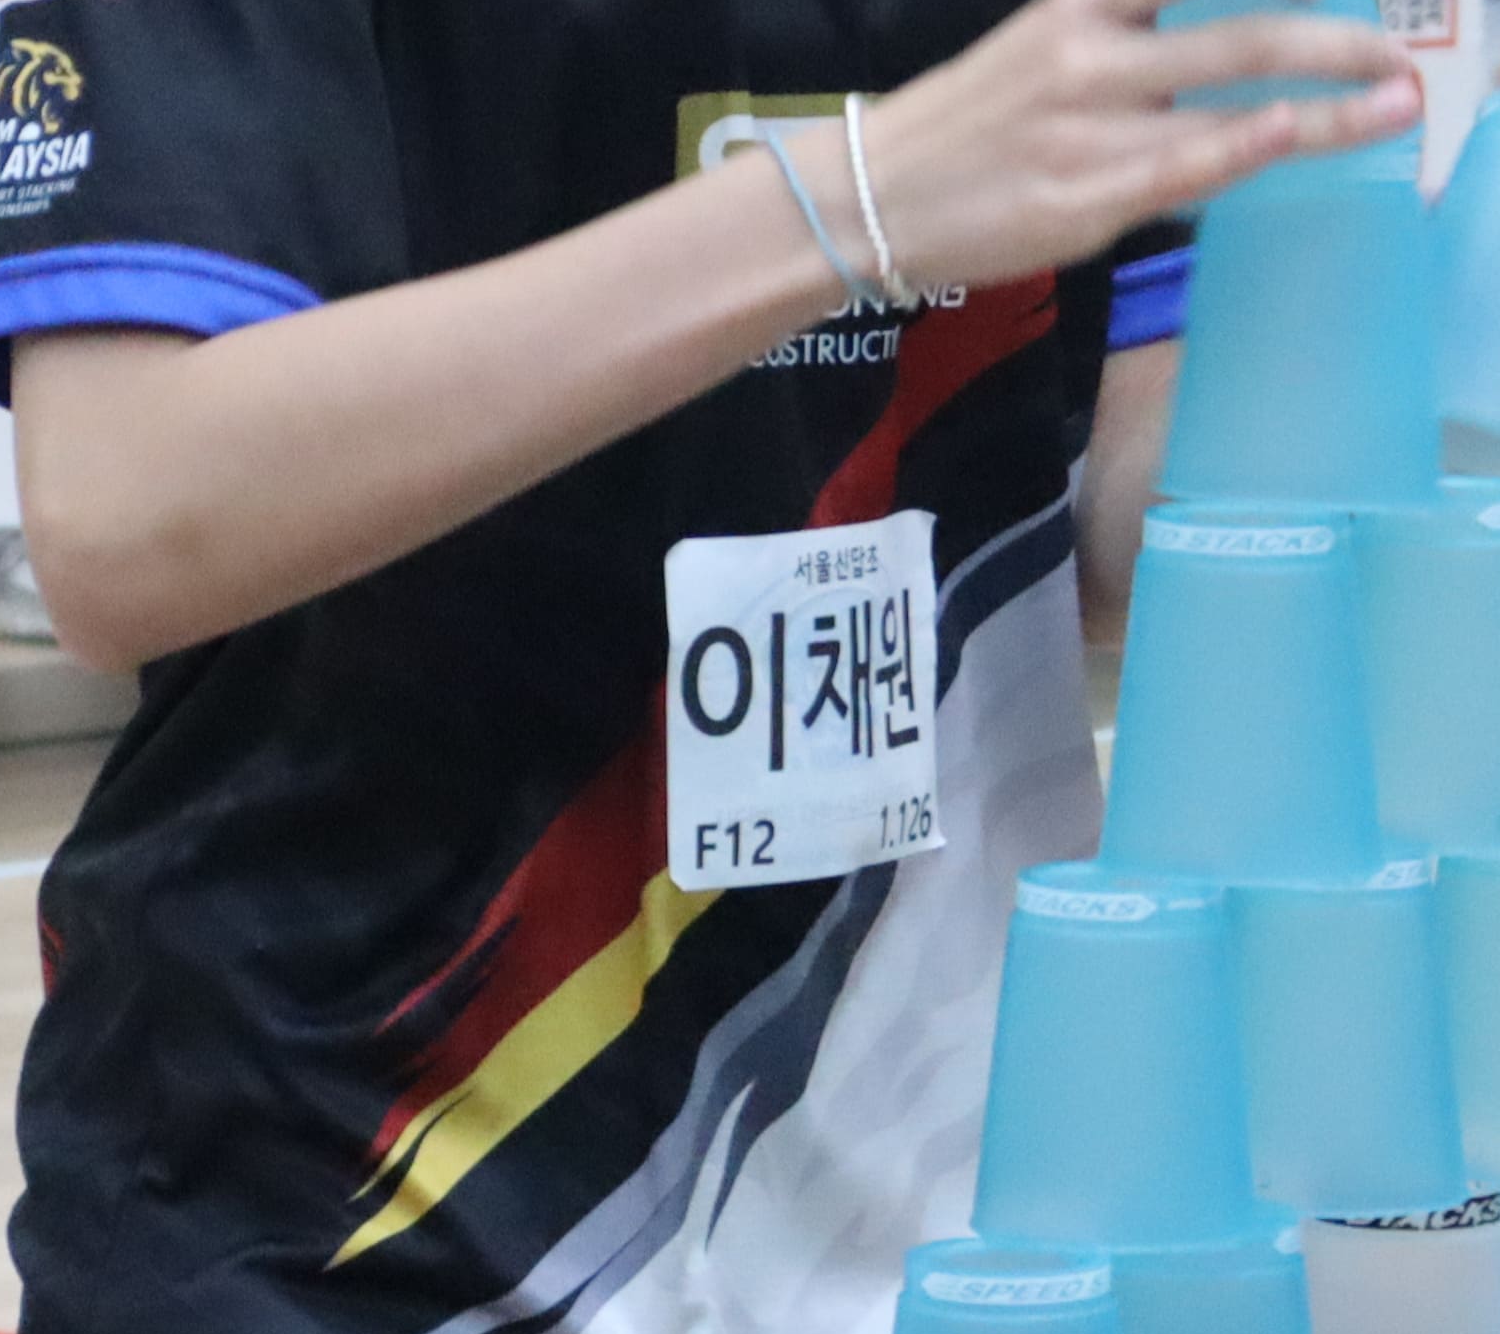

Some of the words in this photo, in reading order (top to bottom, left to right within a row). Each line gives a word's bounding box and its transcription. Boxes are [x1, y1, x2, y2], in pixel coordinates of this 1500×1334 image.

[681, 588, 919, 772] 이채원
[696, 819, 775, 869] F12
[880, 793, 932, 850] 1.126
[1020, 892, 1137, 919] TACKS
[961, 1280, 1083, 1301] SPEED
